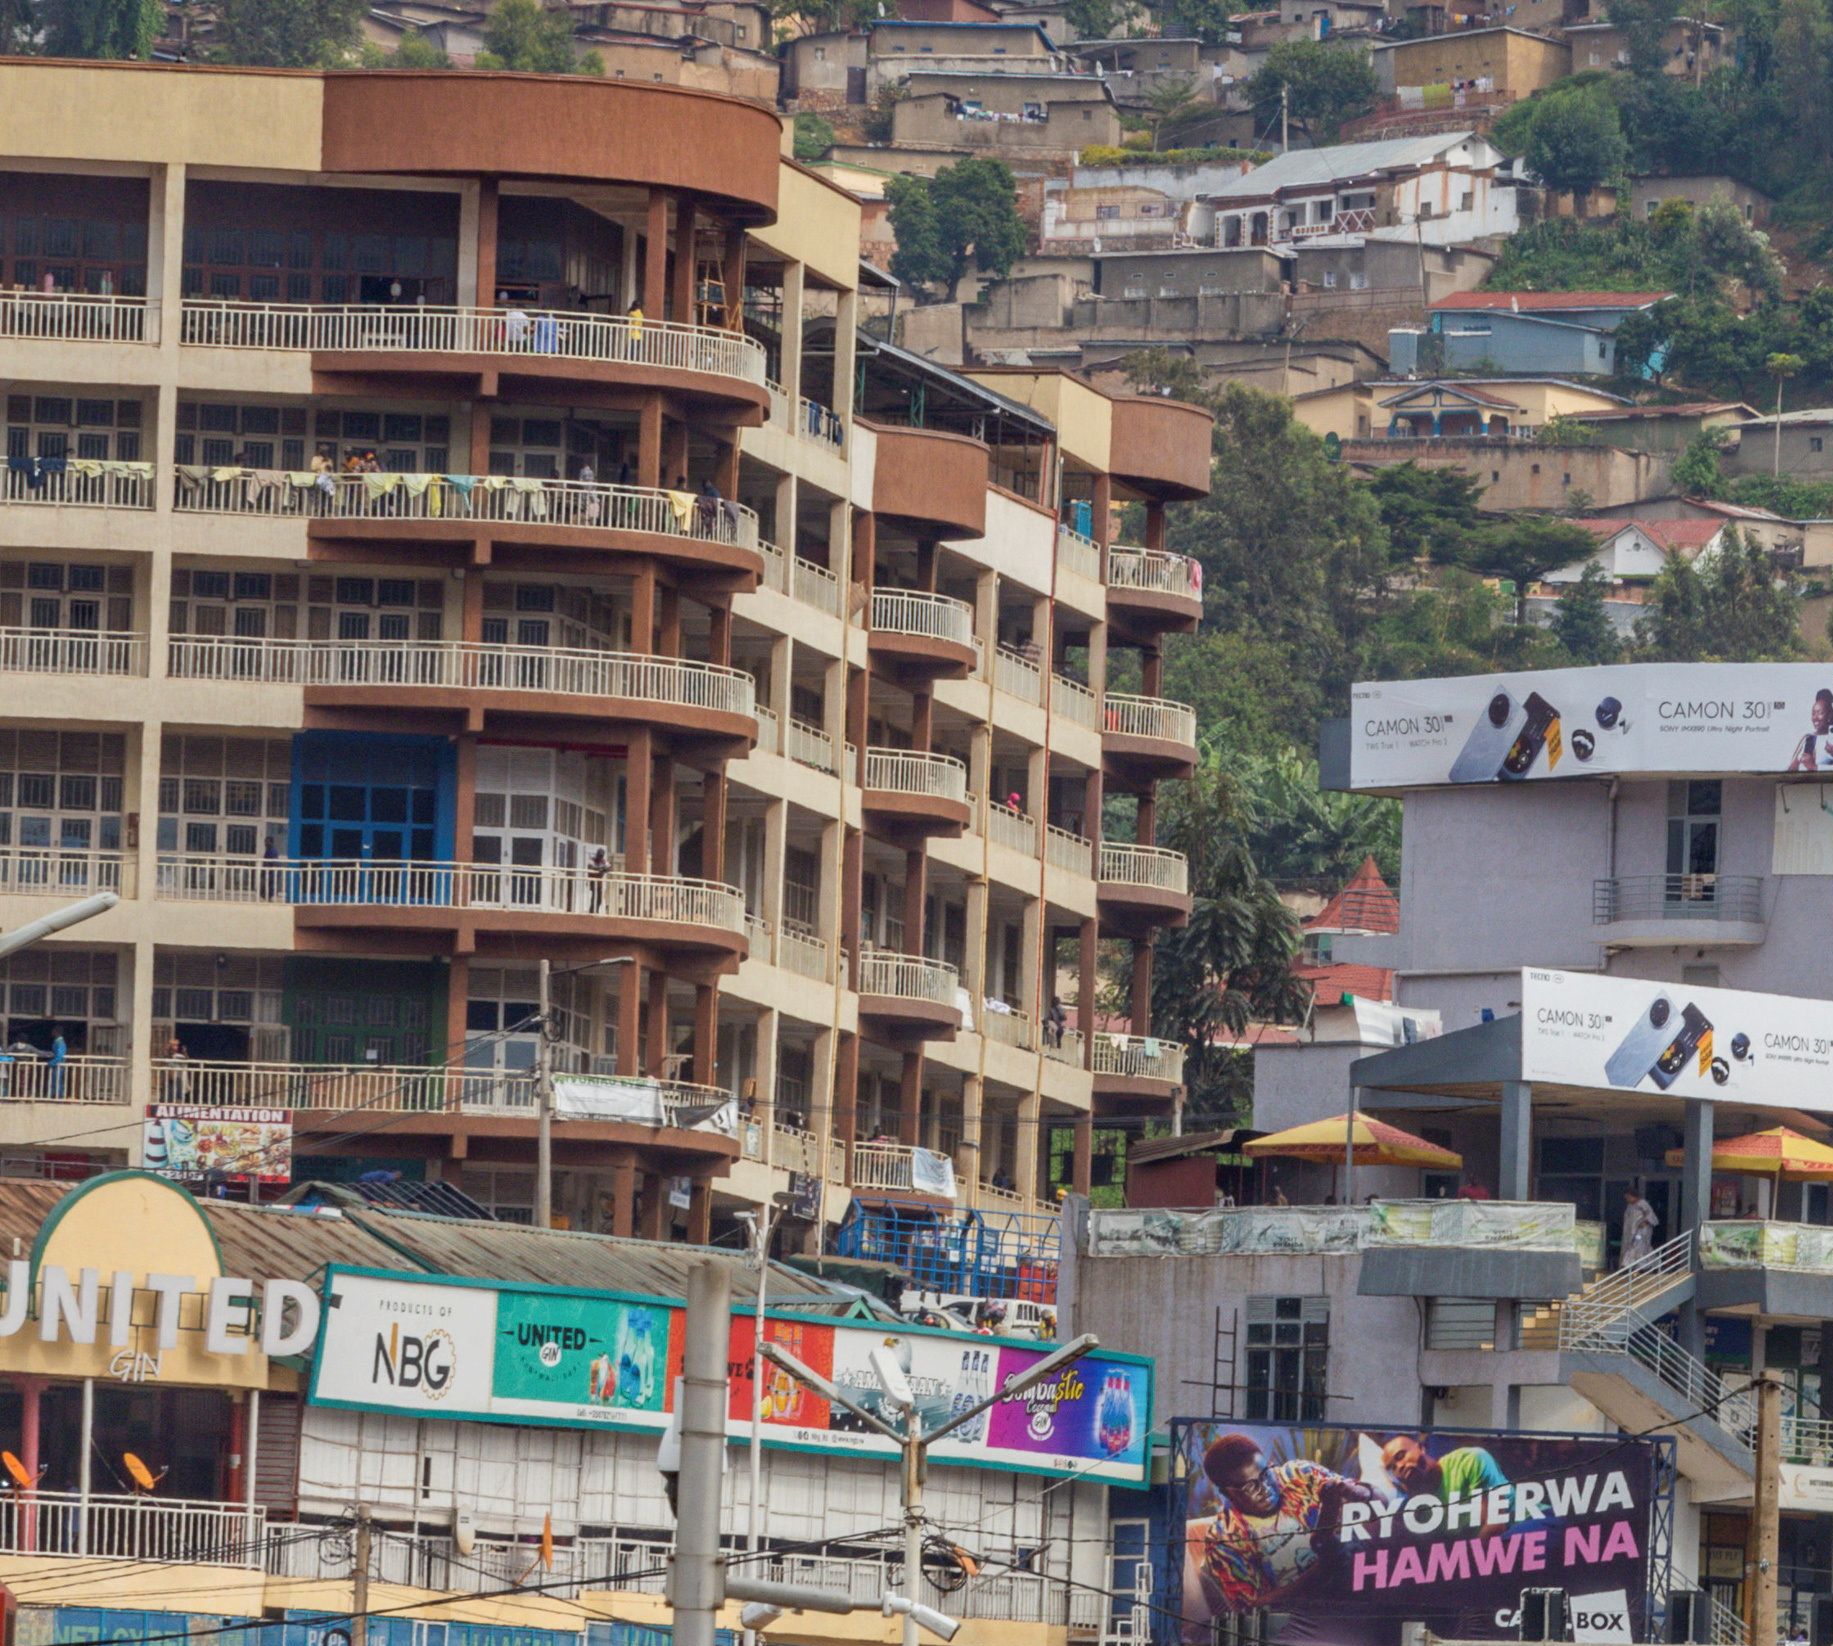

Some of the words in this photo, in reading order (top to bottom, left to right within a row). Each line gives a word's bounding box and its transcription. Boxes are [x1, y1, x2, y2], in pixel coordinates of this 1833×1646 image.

[1659, 701, 1735, 720] CAMON
[1743, 701, 1766, 720] 30
[1365, 717, 1419, 737] CAMON
[1424, 716, 1441, 735] 30
[1537, 1007, 1584, 1028] CAMON
[1588, 1013, 1602, 1030] 30
[1764, 1032, 1810, 1051] CAMON
[1814, 1037, 1828, 1055] 30
[155, 1105, 284, 1122] ALIMENTATION
[378, 1300, 434, 1317] PRODUCTS
[438, 1305, 453, 1318] OF
[518, 1323, 587, 1350] UNITED
[371, 1322, 455, 1391] NBG
[541, 1347, 560, 1361] GIN
[109, 1349, 163, 1383] GIN
[1340, 1470, 1635, 1543] RYOHERWA
[1352, 1530, 1548, 1592] HAMWE
[1563, 1520, 1640, 1567] NA
[1576, 1611, 1625, 1631] BOX
